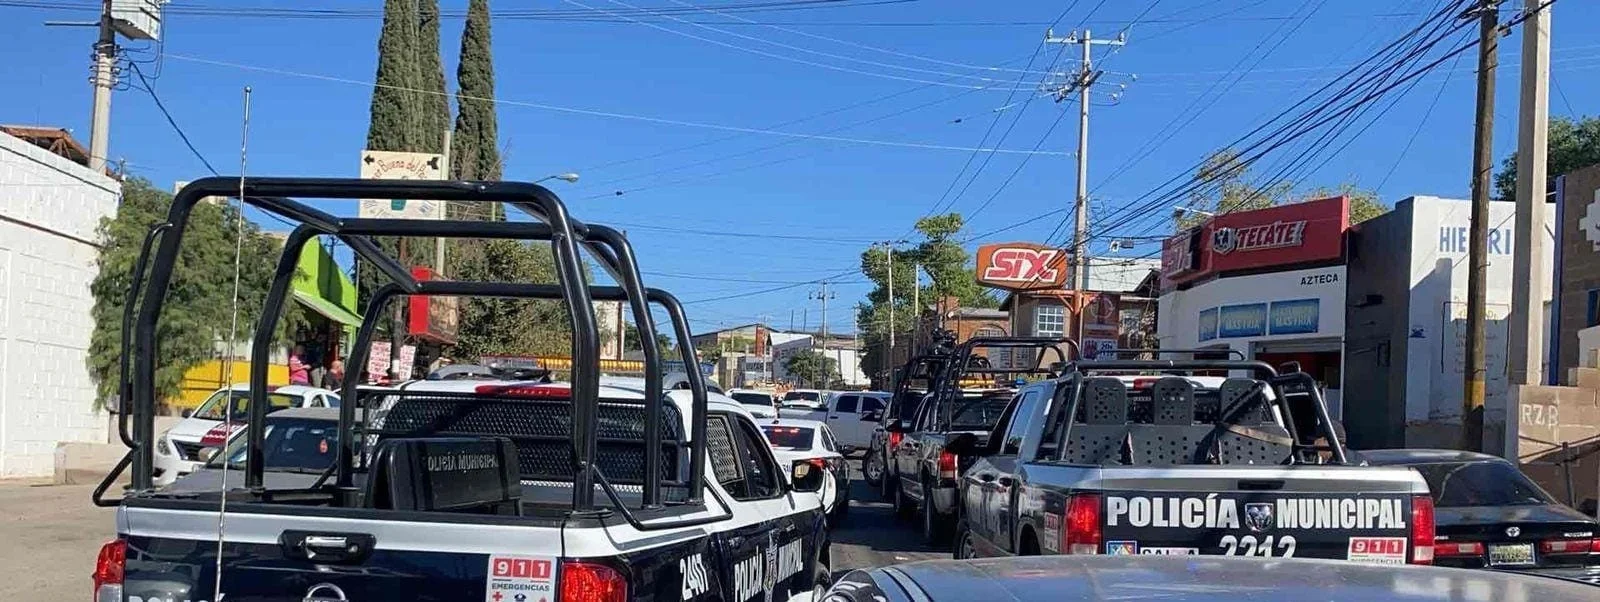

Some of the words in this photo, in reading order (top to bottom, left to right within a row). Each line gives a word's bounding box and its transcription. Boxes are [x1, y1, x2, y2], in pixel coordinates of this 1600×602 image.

[1237, 221, 1300, 249] TECATE
[984, 248, 1059, 282] SIX
[1301, 273, 1338, 286] AZTECA
[1107, 493, 1240, 529] POLICÍA
[1276, 498, 1406, 529] MUNICIPAL
[1219, 535, 1296, 559] 2212
[1355, 541, 1401, 553] 911
[496, 560, 548, 577] 911
[492, 582, 550, 591] EMERGENCIAS
